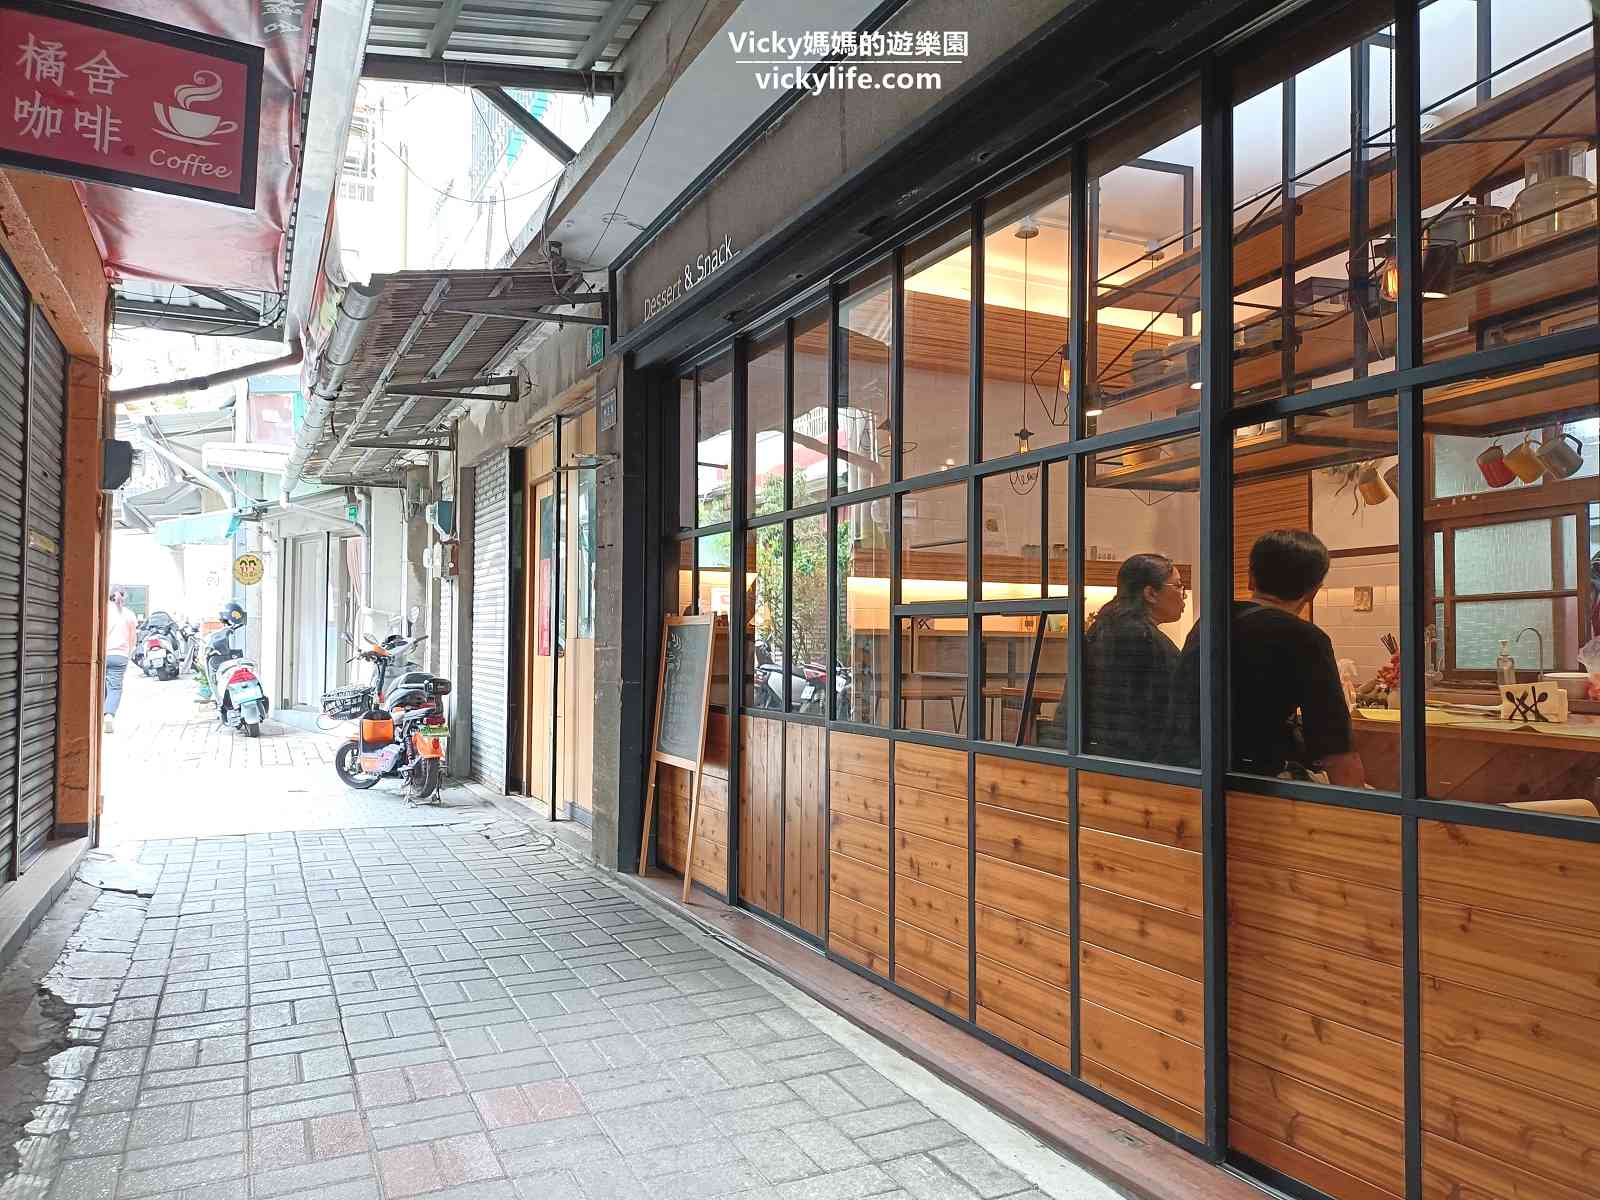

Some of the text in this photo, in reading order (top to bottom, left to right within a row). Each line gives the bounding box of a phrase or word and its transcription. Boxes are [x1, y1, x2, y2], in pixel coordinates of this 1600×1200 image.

[16, 31, 128, 96] 橘舍
[14, 90, 123, 155] 咖啡
[149, 148, 233, 178] Coffee
[644, 233, 733, 322] Dessert & Snack
